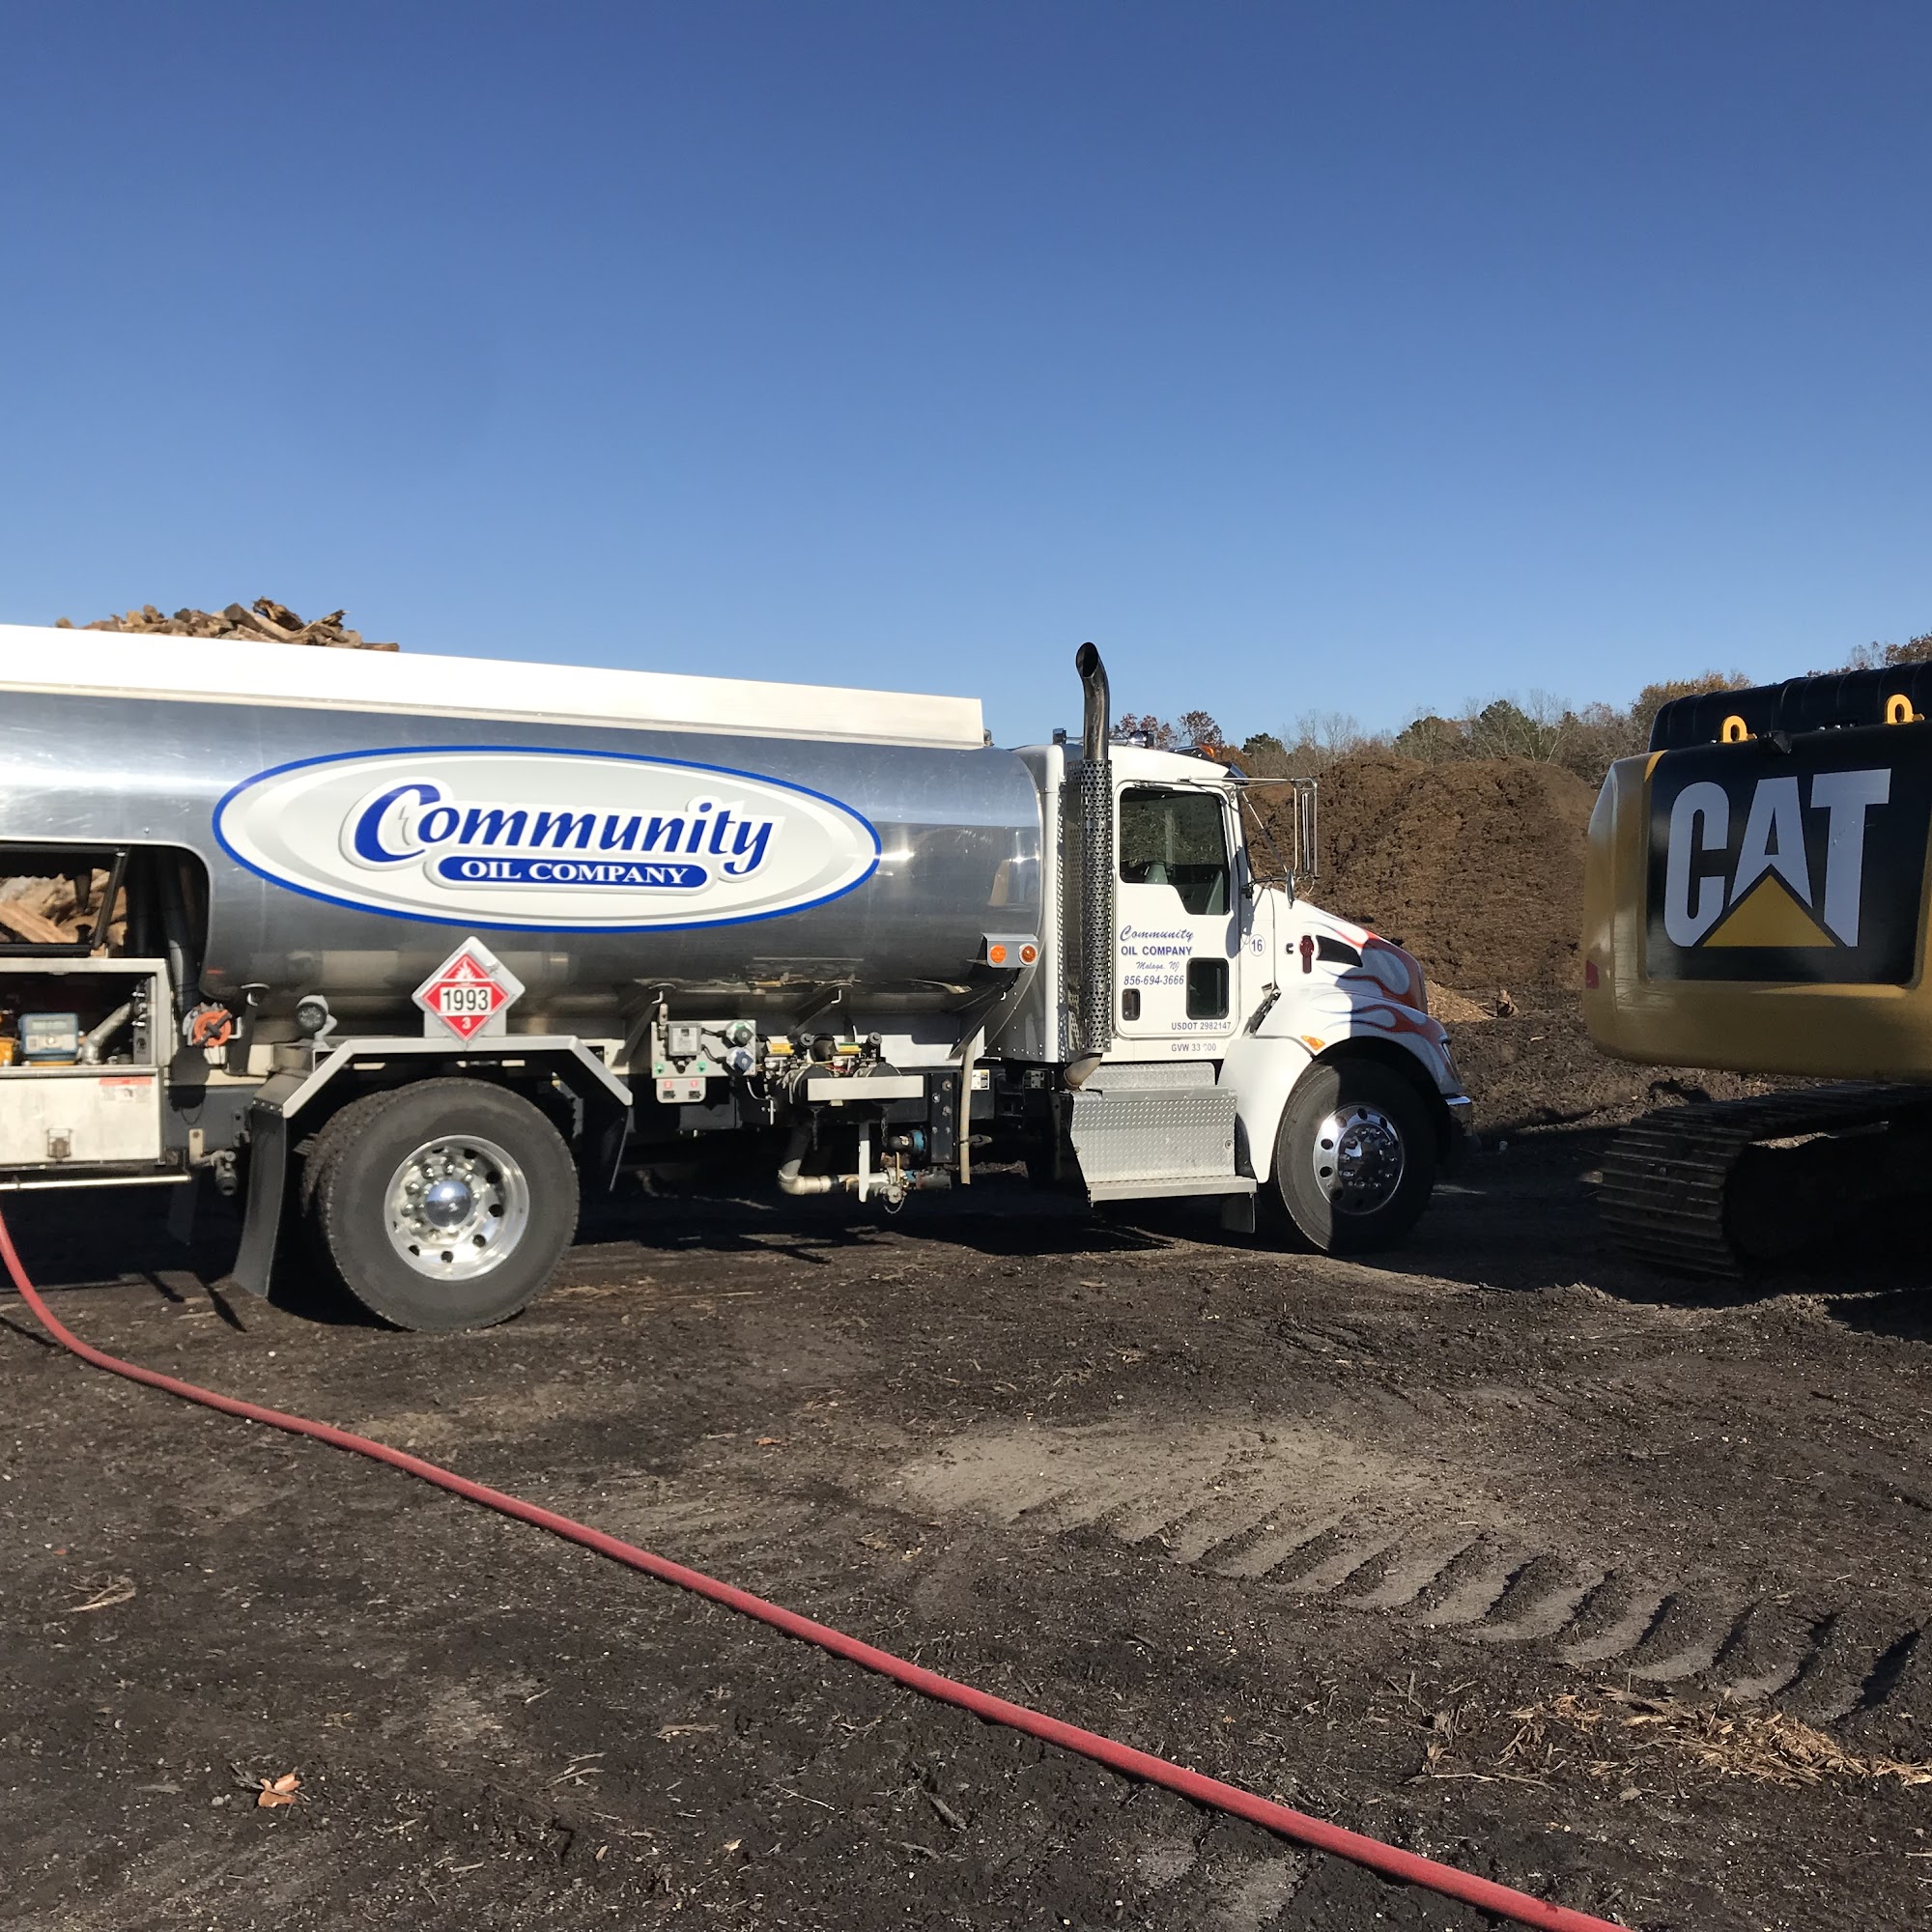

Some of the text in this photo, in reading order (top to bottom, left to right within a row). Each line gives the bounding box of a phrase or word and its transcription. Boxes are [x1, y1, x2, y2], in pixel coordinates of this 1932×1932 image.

[354, 783, 774, 876] Community
[1664, 768, 1891, 947] CAT
[461, 861, 690, 885] OIL COMPANY
[1120, 924, 1194, 943] Community
[1121, 946, 1193, 955] OIL COMPANY
[1251, 938, 1263, 952] 16
[1123, 975, 1185, 985] 856-694-3666
[442, 989, 489, 1011] 1993
[462, 1016, 471, 1030] 3
[1171, 1021, 1232, 1031] USDOT 2982147
[1171, 1043, 1189, 1052] GVW
